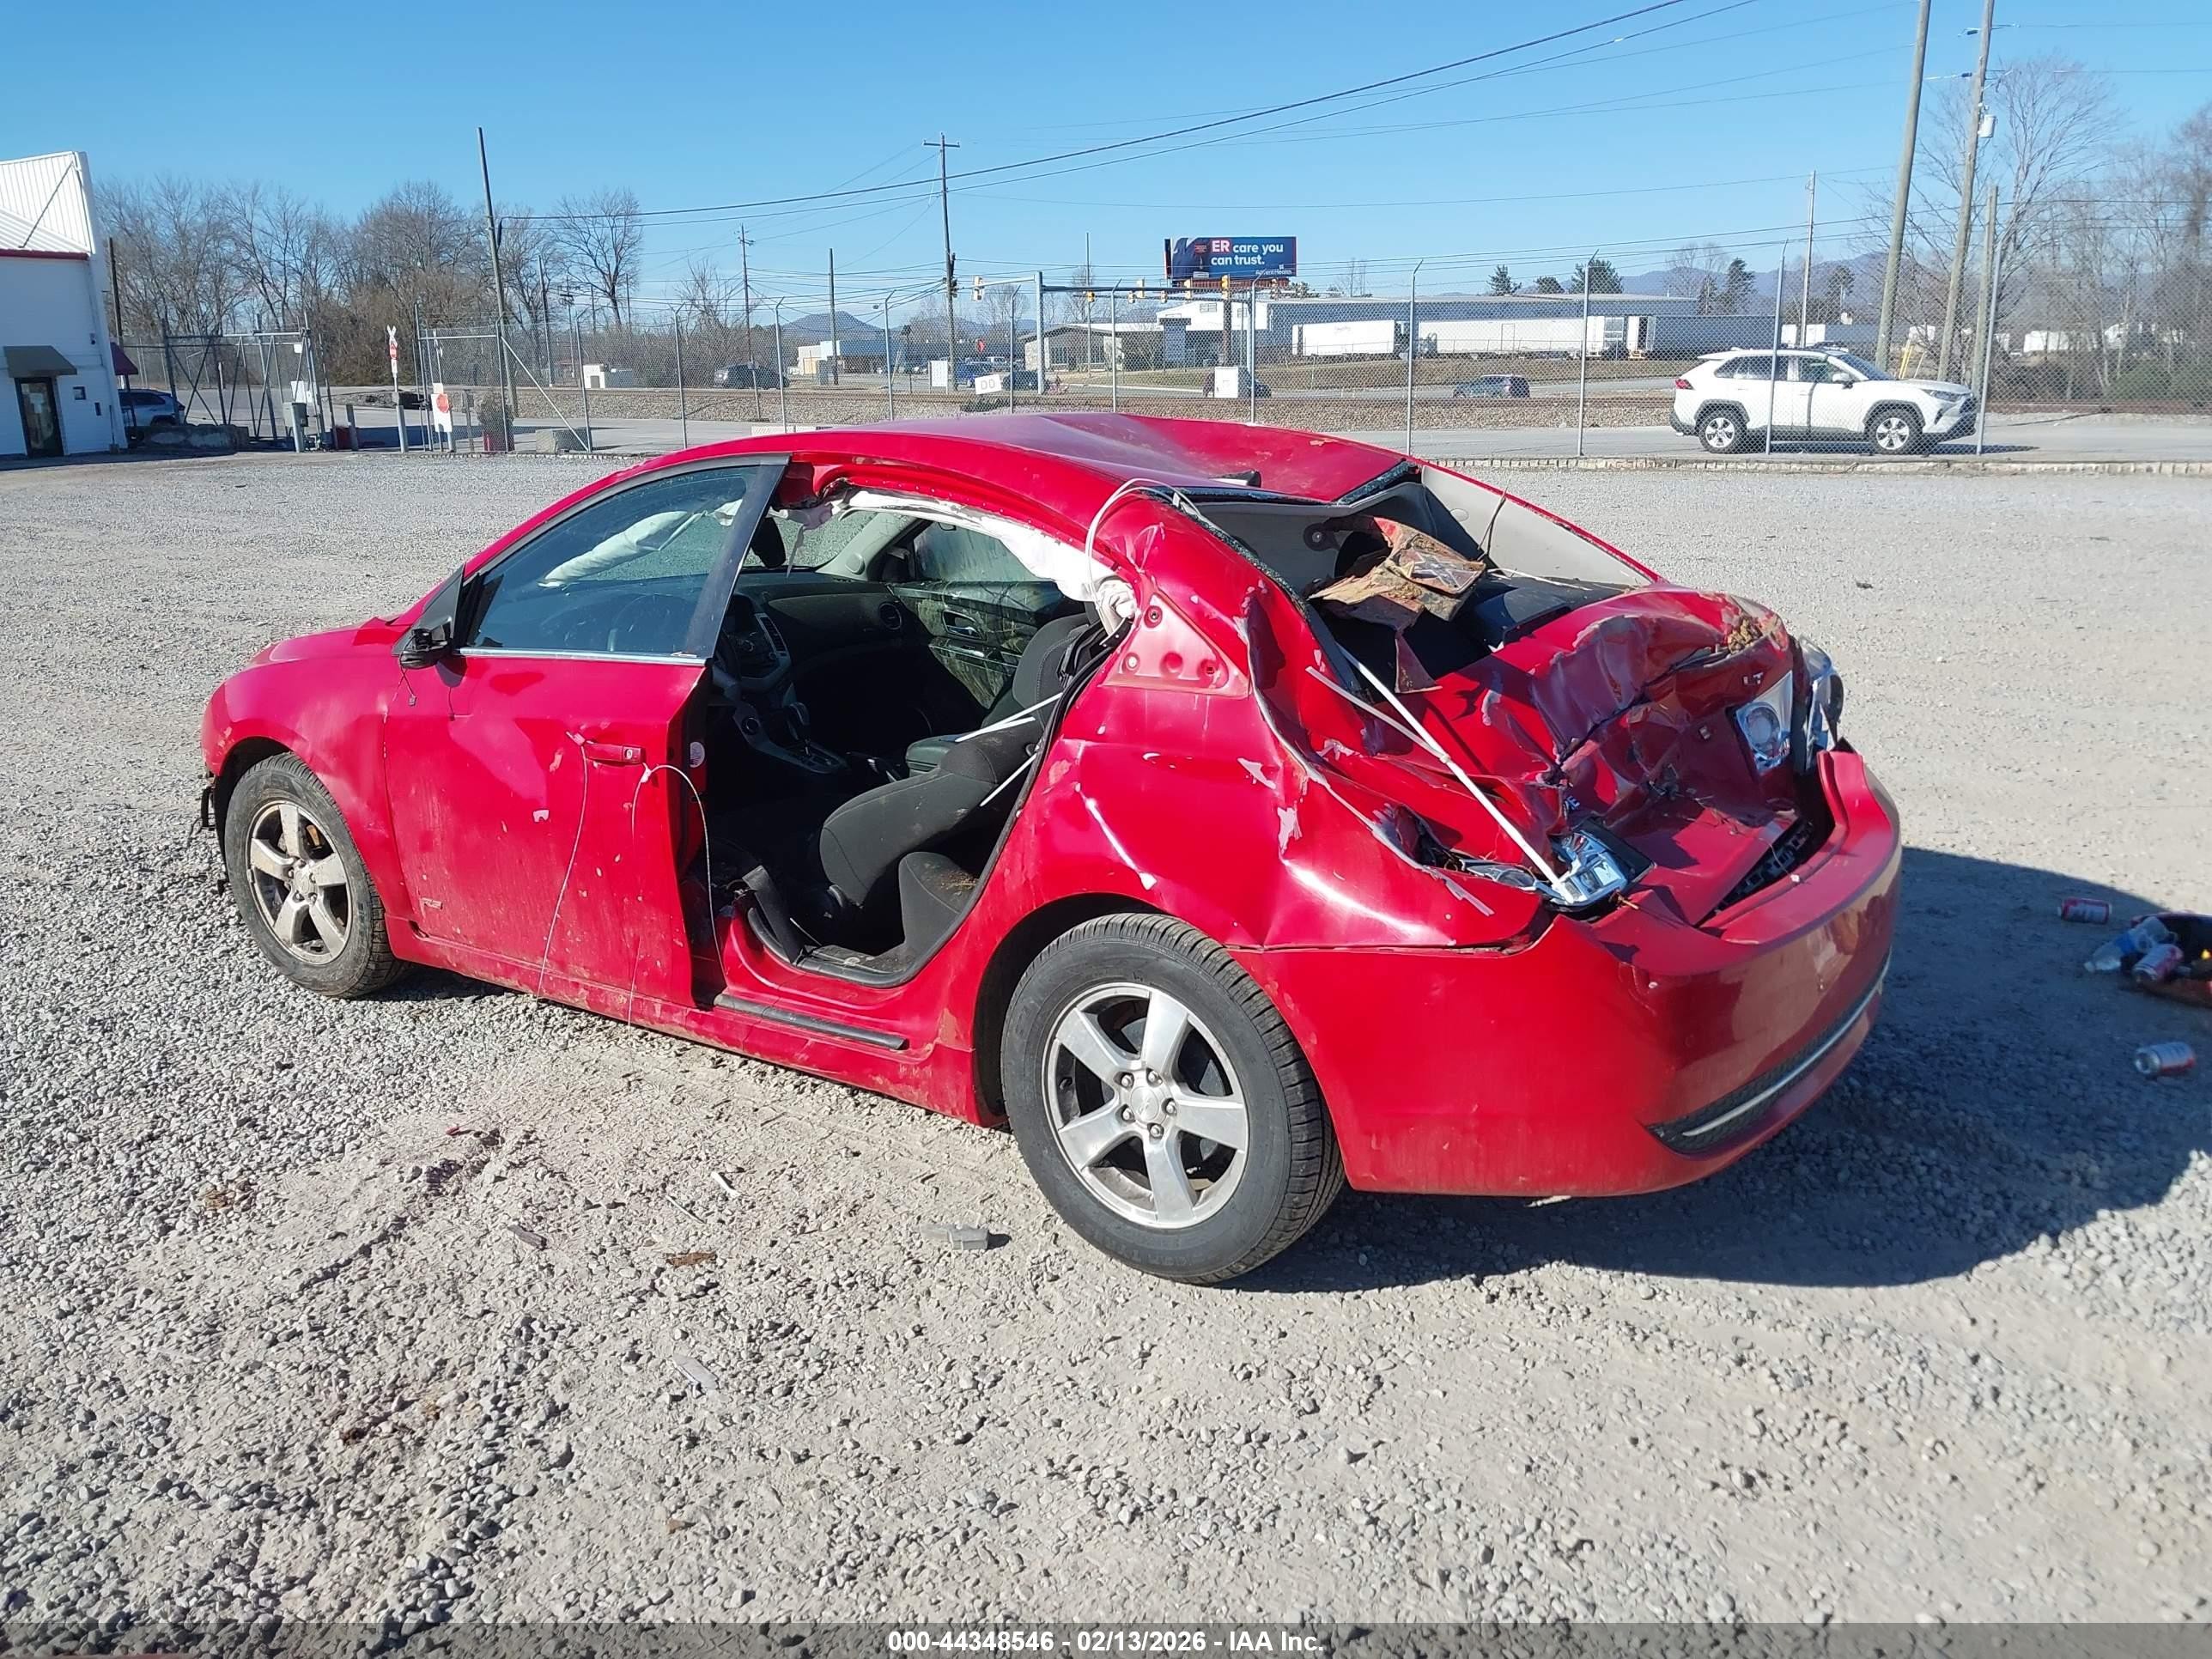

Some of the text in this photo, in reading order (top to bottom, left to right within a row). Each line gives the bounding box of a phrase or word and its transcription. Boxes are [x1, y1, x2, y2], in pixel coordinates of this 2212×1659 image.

[1212, 240, 1231, 252] ER
[1232, 244, 1259, 253] care
[1261, 244, 1284, 256] you
[1211, 254, 1265, 265] can trust.
